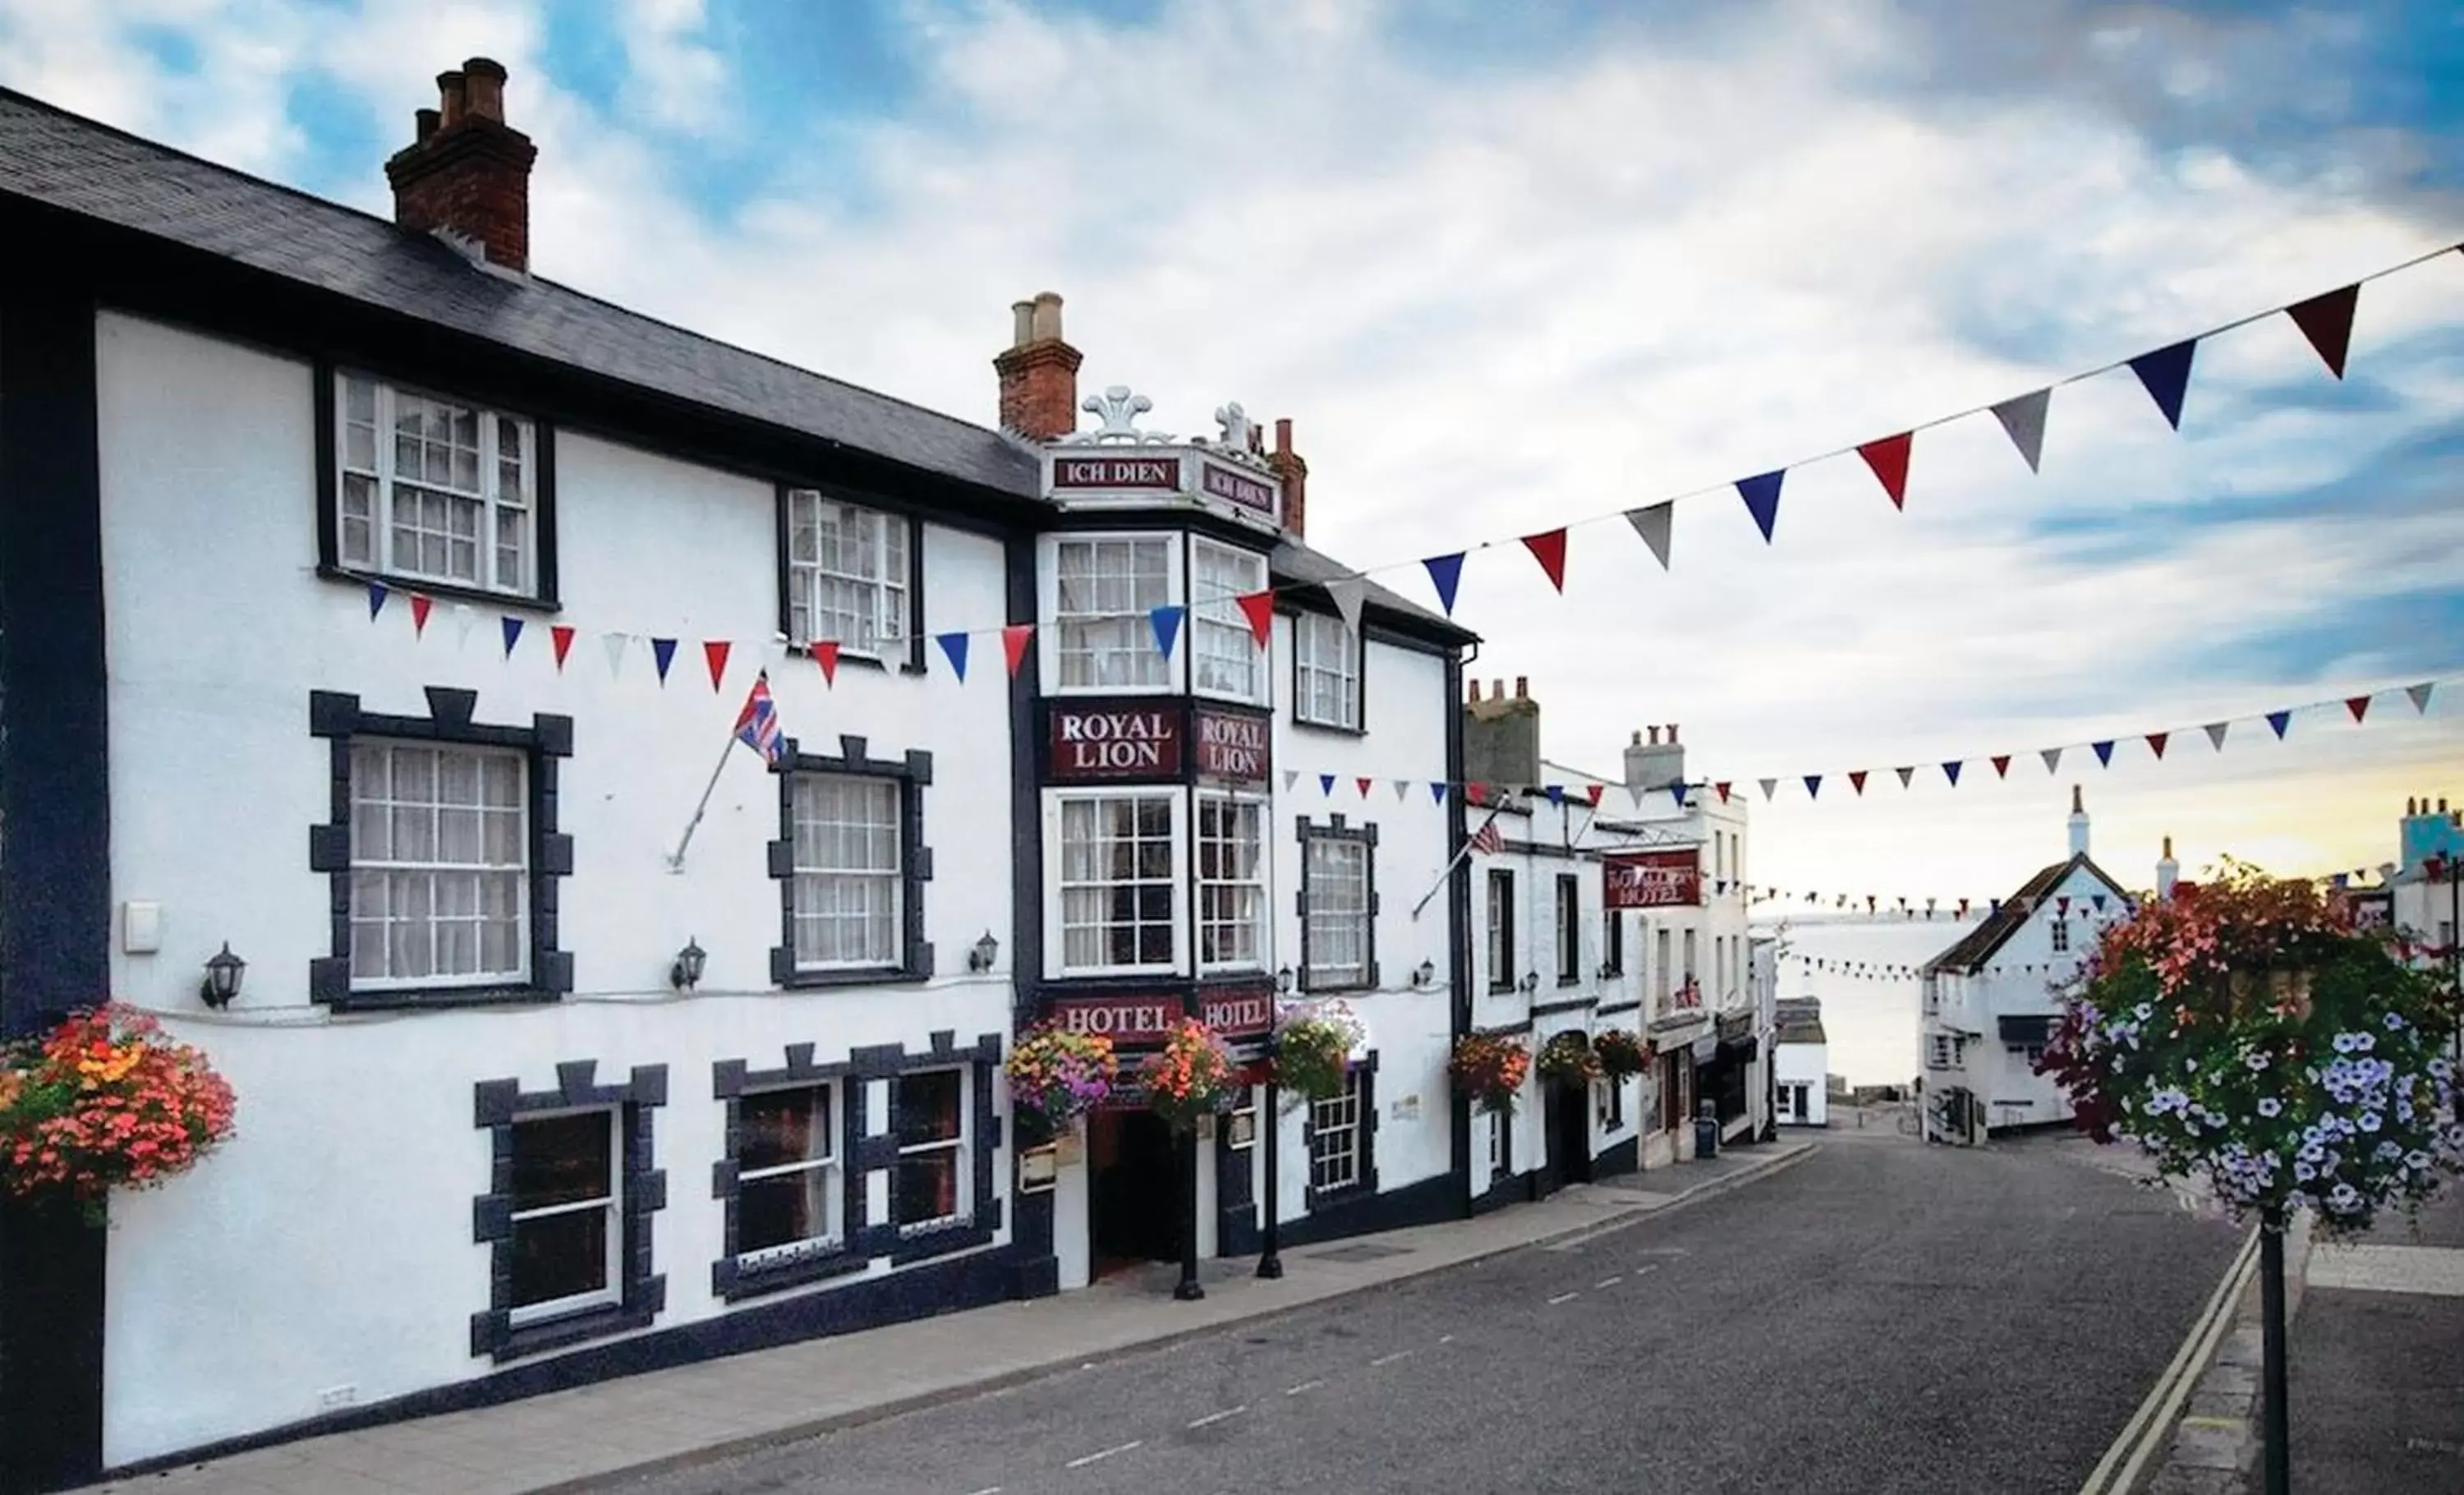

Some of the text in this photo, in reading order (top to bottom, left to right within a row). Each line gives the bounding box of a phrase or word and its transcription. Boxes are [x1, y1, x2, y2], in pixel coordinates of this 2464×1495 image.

[1067, 462, 1168, 482] ICH DIEN
[1061, 713, 1172, 741] ROYAL
[1200, 715, 1265, 749] ROYAL
[1073, 740, 1160, 769] LION
[1208, 743, 1258, 774] LION
[1205, 999, 1266, 1027] HOTEL
